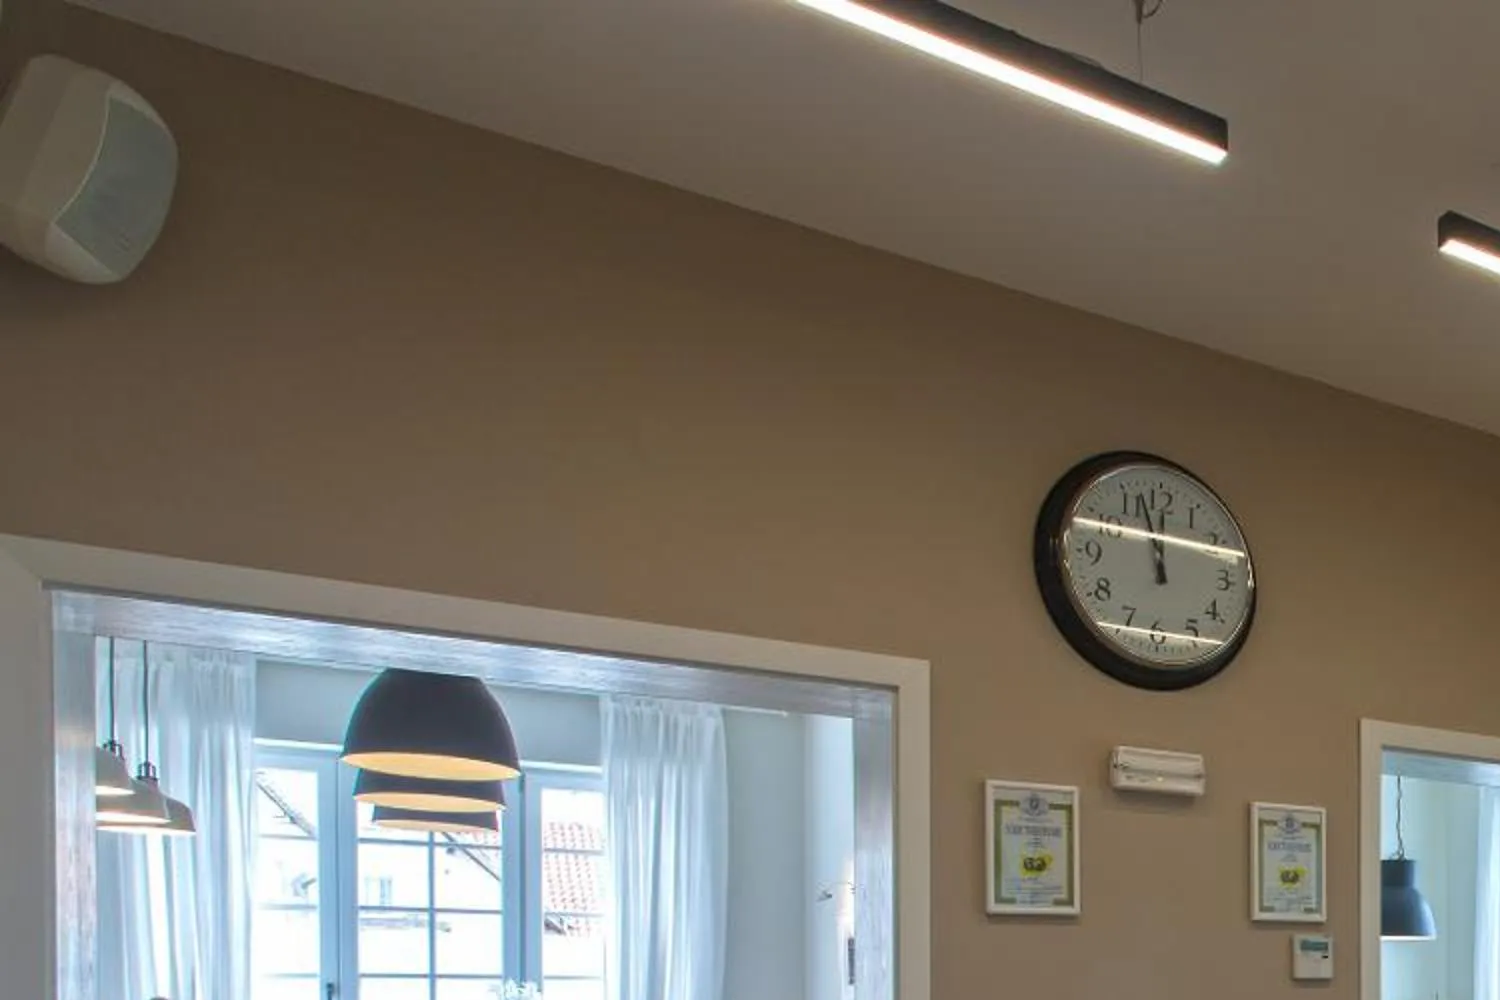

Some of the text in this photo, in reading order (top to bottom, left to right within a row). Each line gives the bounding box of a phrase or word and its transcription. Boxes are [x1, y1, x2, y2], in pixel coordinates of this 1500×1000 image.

[1149, 489, 1173, 515] 12
[1188, 507, 1196, 530] 1
[1085, 541, 1102, 566] 9
[1094, 577, 1111, 601] 8
[1217, 569, 1230, 592] 3
[1121, 605, 1137, 627] 7
[1204, 599, 1218, 621] 4
[1150, 619, 1167, 646] 6
[1185, 619, 1200, 638] 5
